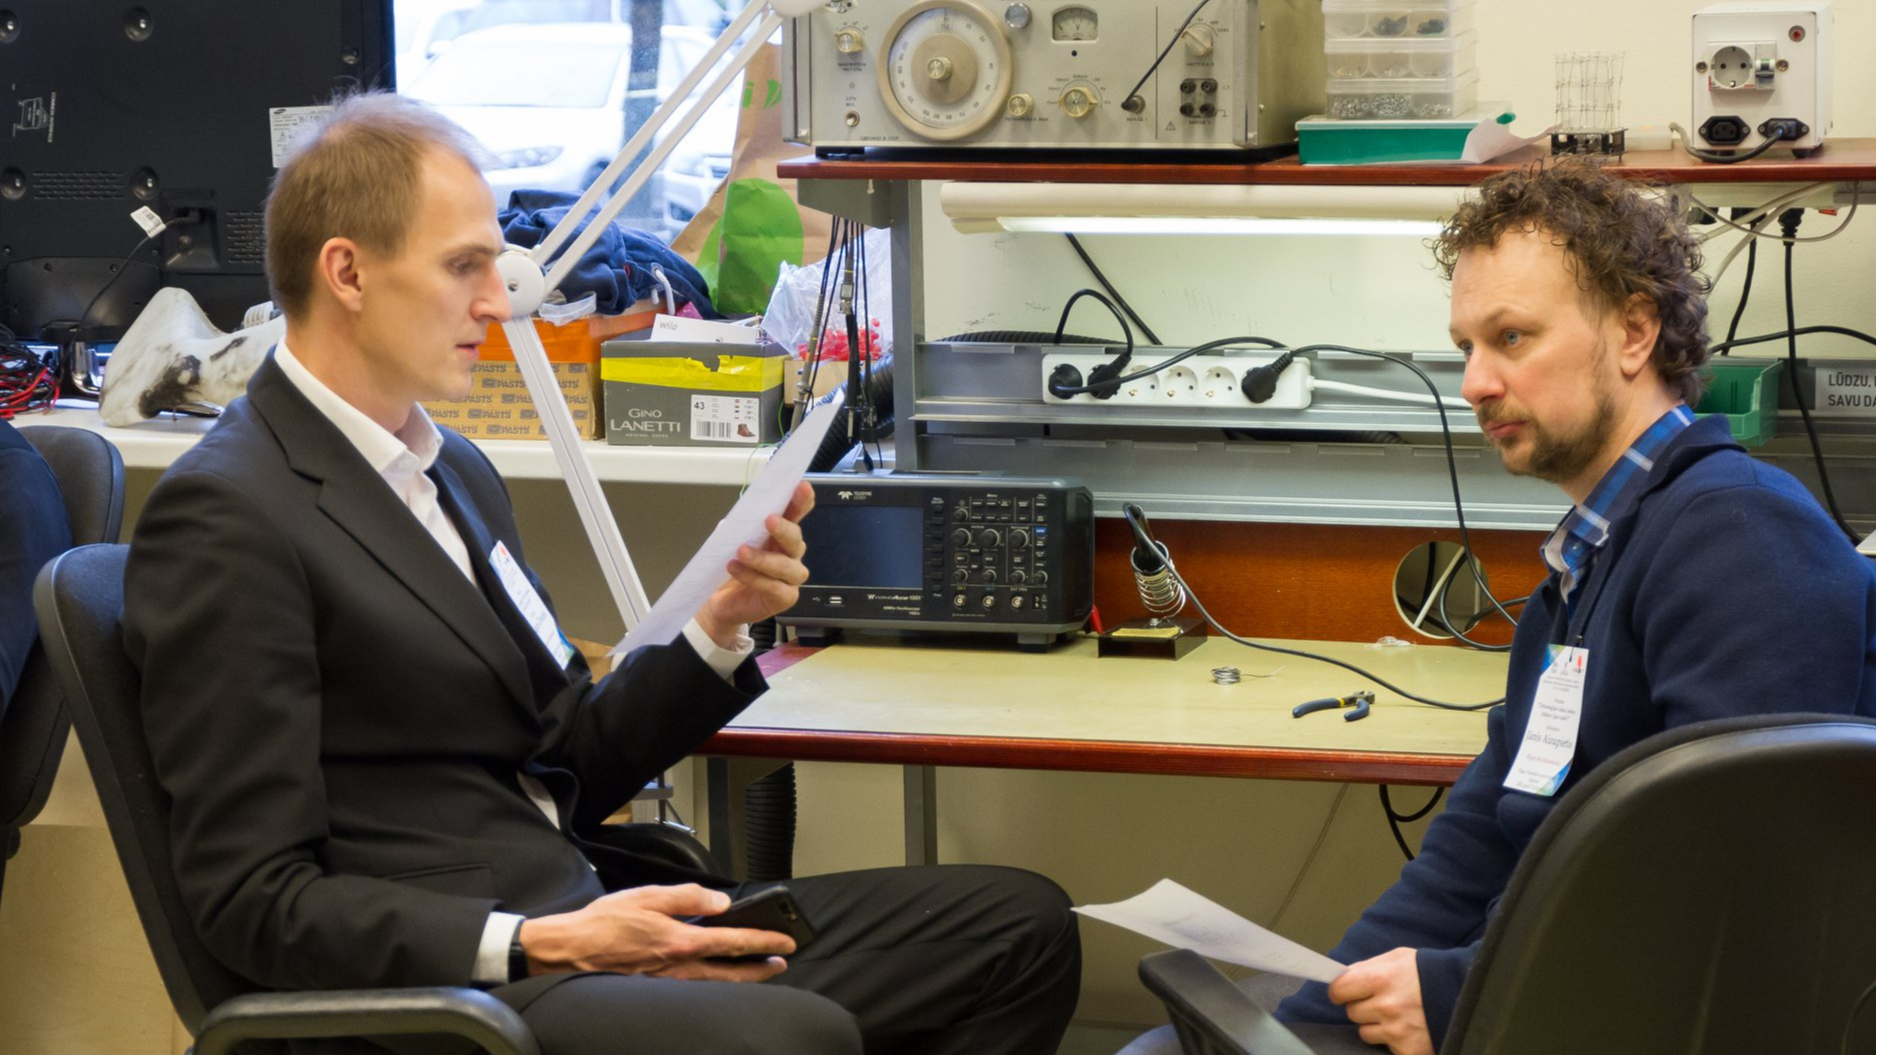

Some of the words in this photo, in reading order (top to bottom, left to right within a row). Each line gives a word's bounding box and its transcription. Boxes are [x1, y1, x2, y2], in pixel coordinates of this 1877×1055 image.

[660, 321, 678, 331] wilo
[1828, 372, 1871, 388] LŪDZU,
[1828, 394, 1860, 407] SAVU
[694, 402, 705, 410] 43
[431, 409, 459, 418] PASTS
[482, 410, 511, 418] PASTS
[628, 408, 662, 418] GINO
[501, 425, 530, 434] PASTS
[610, 419, 680, 432] LANETTI
